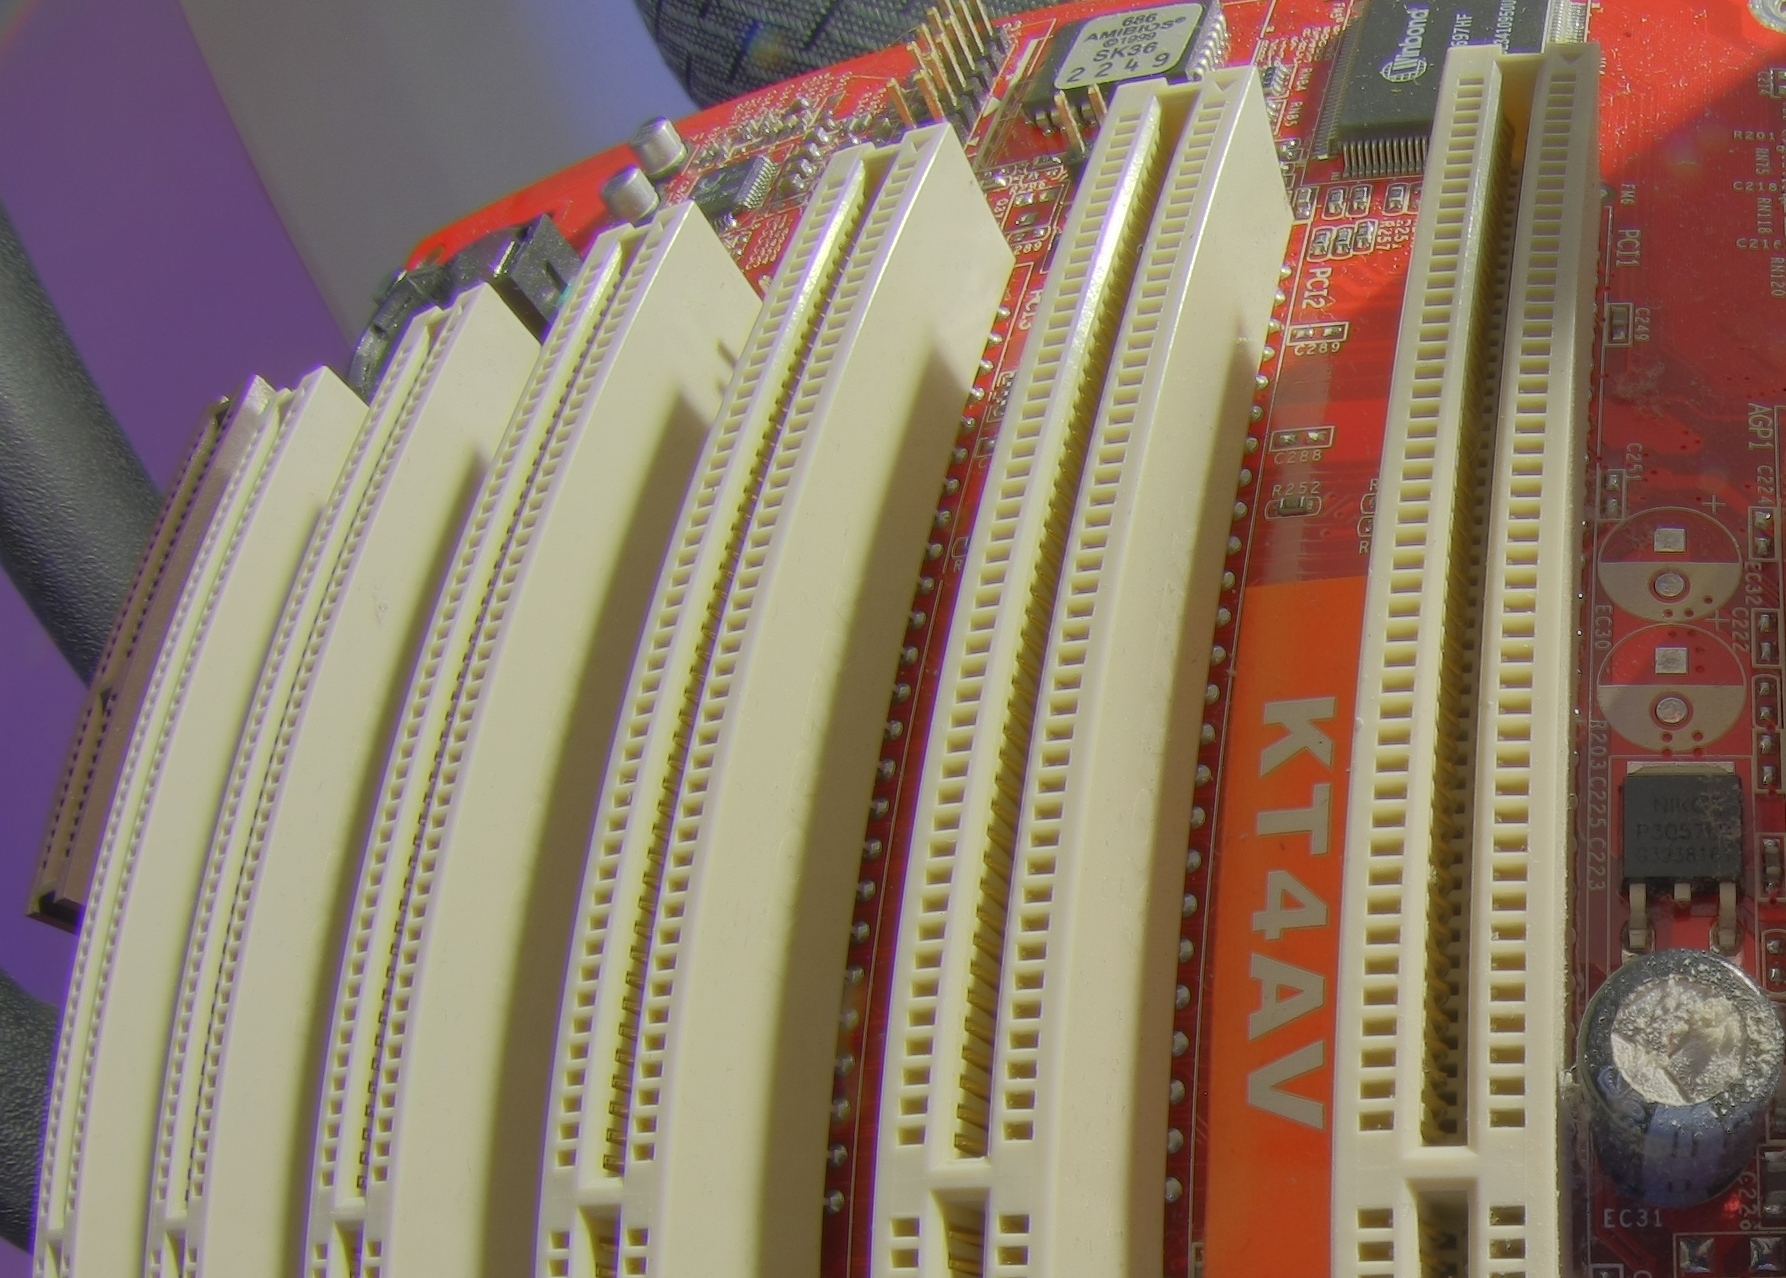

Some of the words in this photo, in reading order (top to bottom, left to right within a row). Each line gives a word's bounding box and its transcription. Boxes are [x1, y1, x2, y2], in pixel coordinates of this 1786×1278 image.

[1122, 13, 1159, 27] 686
[1093, 41, 1160, 62] SK36
[1732, 130, 1776, 142] R201
[1615, 229, 1642, 269] PCI1
[1302, 266, 1332, 310] PCI2
[1293, 341, 1341, 356] C289
[1746, 402, 1775, 451] AGP1
[1274, 449, 1323, 465] C288
[1272, 480, 1321, 498] R252
[1744, 562, 1764, 606] EC32
[1594, 604, 1614, 651] EC30
[1730, 607, 1751, 654] C222
[1588, 720, 1609, 771] R203
[1588, 776, 1608, 828] C225
[1588, 837, 1608, 894] C223
[1247, 696, 1336, 1131] KT4AV
[1603, 1208, 1664, 1229] EC31
